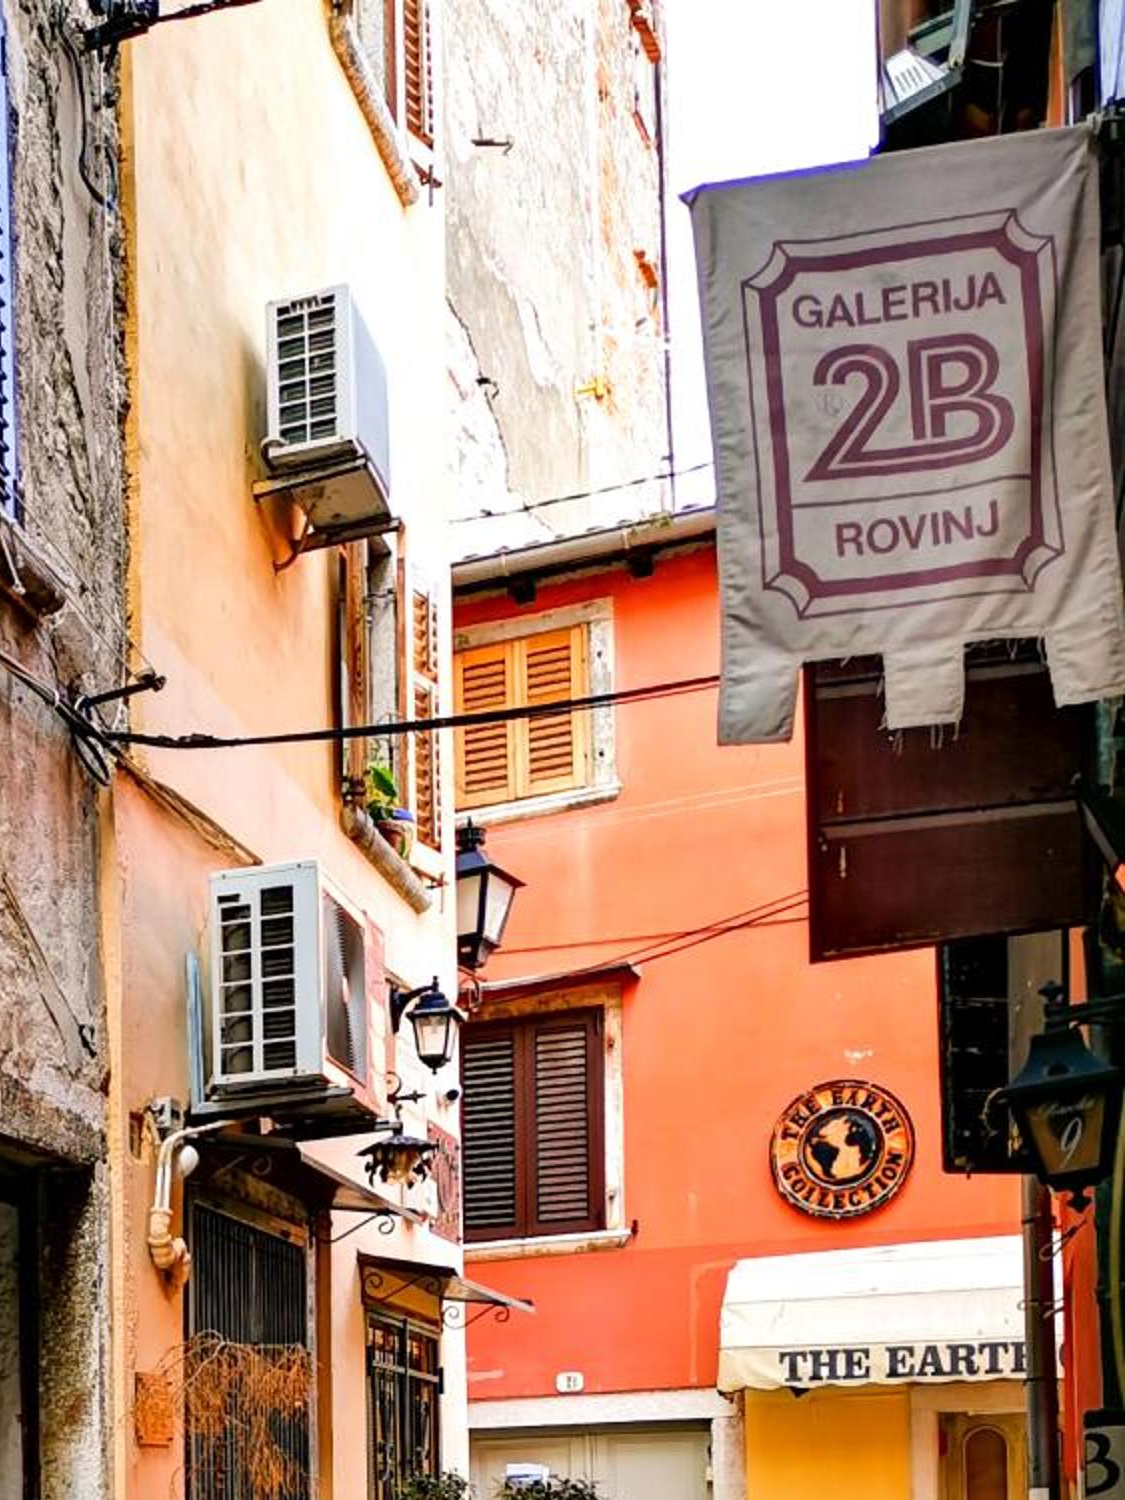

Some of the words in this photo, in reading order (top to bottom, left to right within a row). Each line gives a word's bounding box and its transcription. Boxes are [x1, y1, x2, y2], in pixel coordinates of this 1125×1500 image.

[791, 271, 1006, 329] GALERIJA
[802, 333, 1016, 482] 2B
[835, 501, 999, 556] ROVINJ
[781, 1092, 822, 1140] THE
[832, 1089, 901, 1135] EARTH
[781, 1151, 903, 1209] COLLECTION
[779, 1348, 870, 1382] THE
